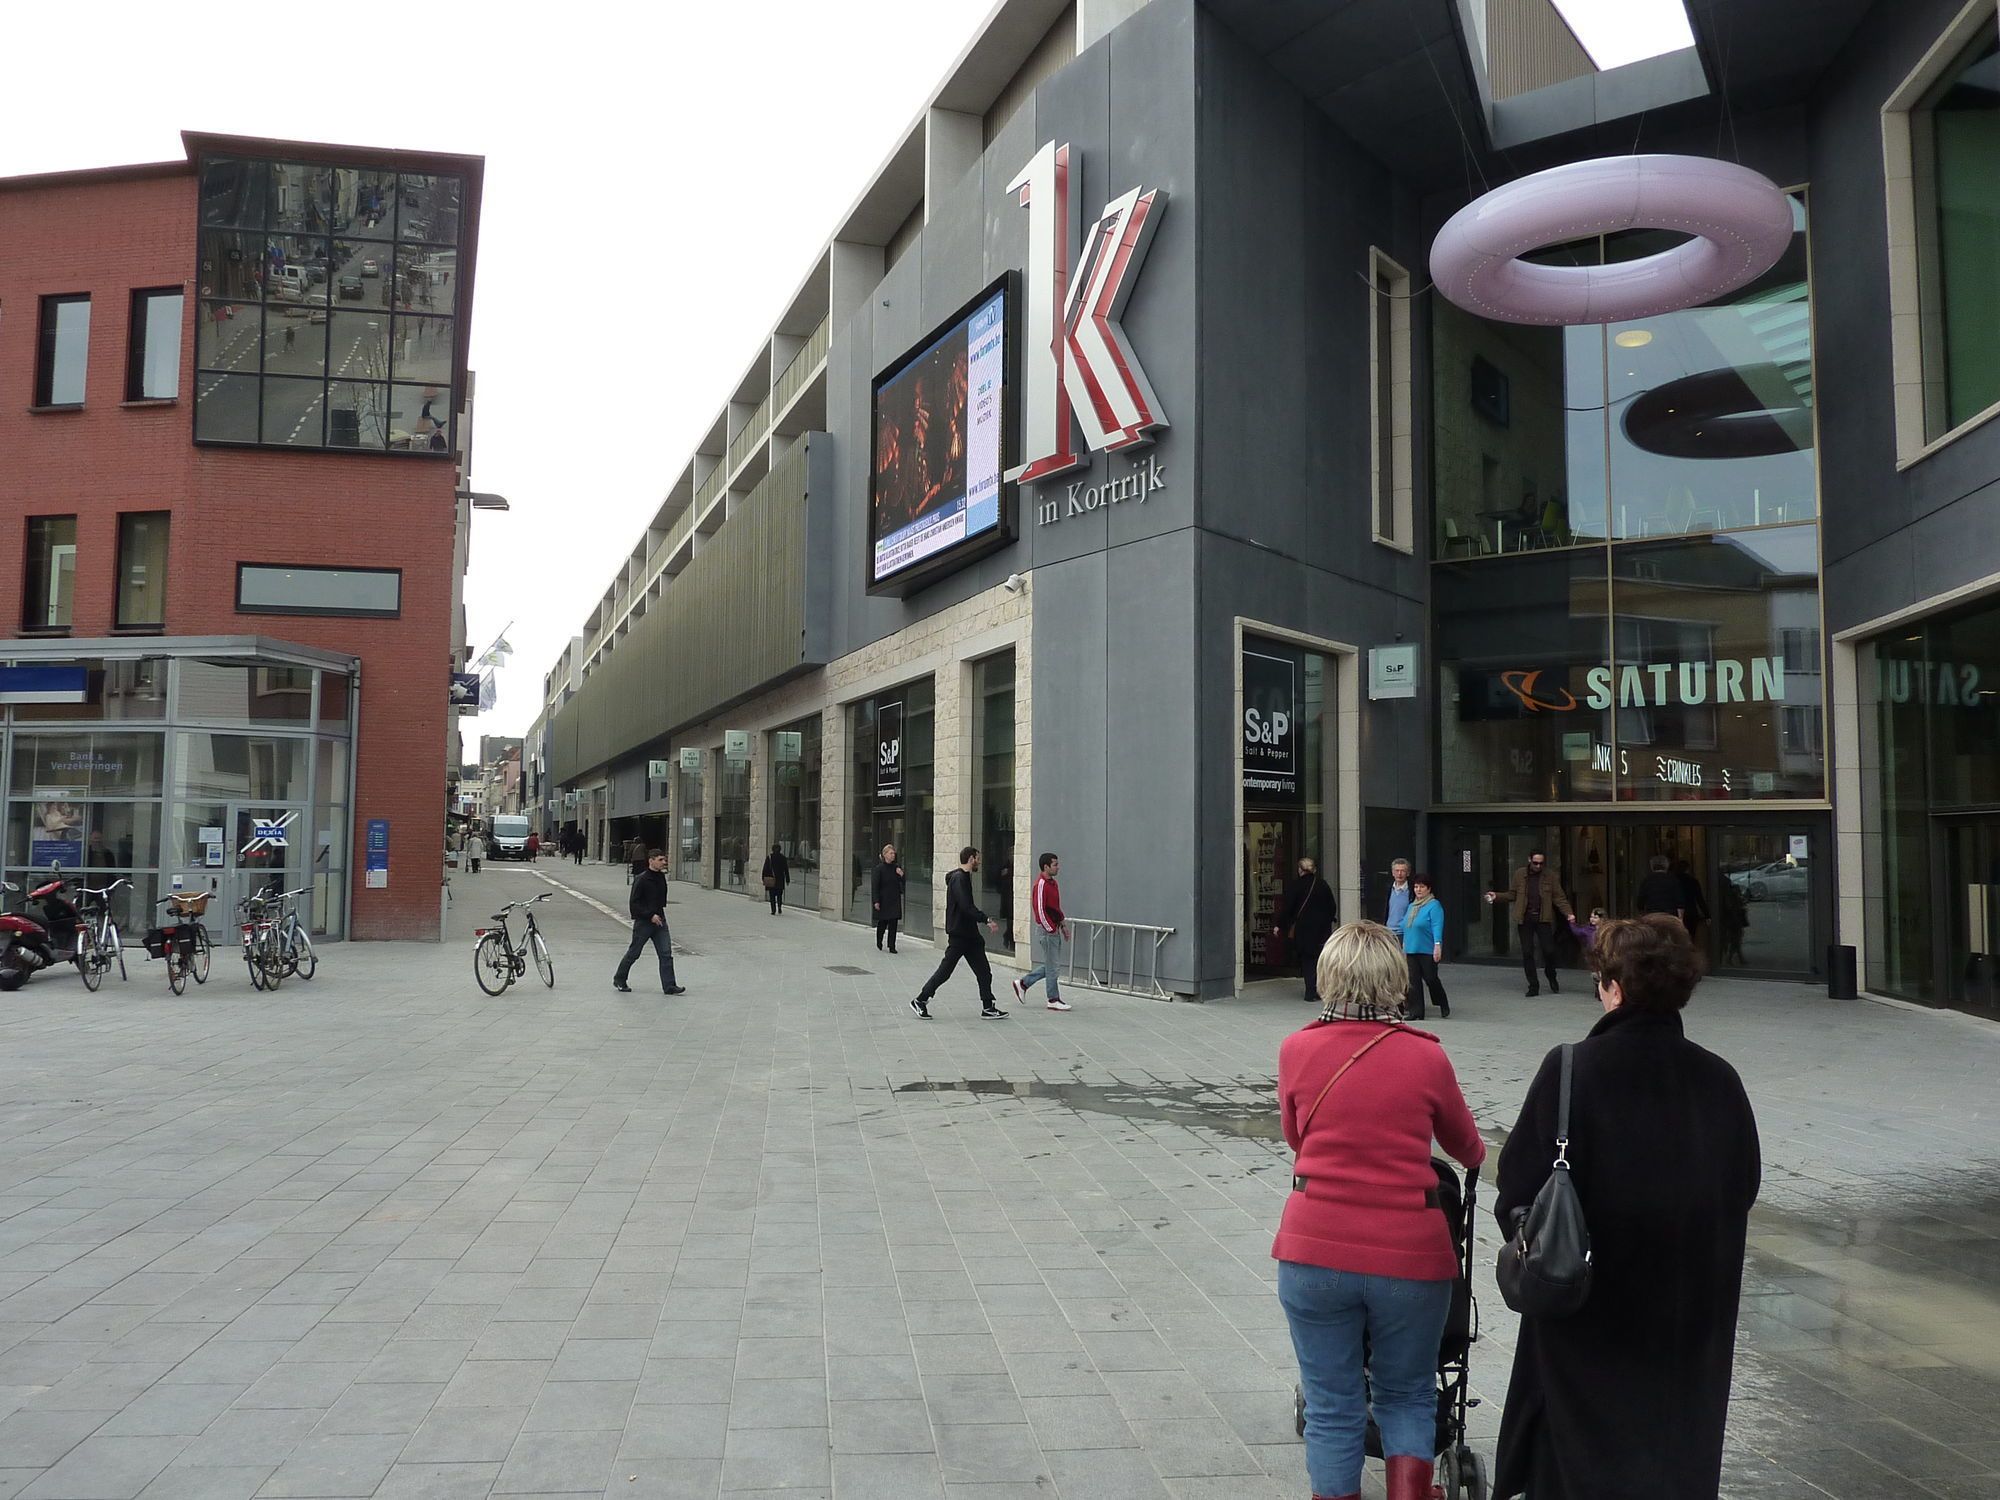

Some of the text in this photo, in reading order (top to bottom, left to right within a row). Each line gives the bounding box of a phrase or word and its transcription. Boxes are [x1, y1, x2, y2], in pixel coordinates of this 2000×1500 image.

[1038, 454, 1165, 525] in Kortrijk
[1386, 664, 1404, 673] S&P
[1586, 656, 1785, 710] SATURN
[1245, 707, 1289, 746] S&P
[70, 752, 94, 761] Bank
[881, 740, 899, 767] S&P
[1245, 746, 1289, 760] Salt & Pepper
[51, 761, 123, 773] Verzekeringen
[655, 763, 662, 775] k
[1667, 759, 1702, 787] CRINKLES
[1243, 777, 1296, 794] ontemporary living
